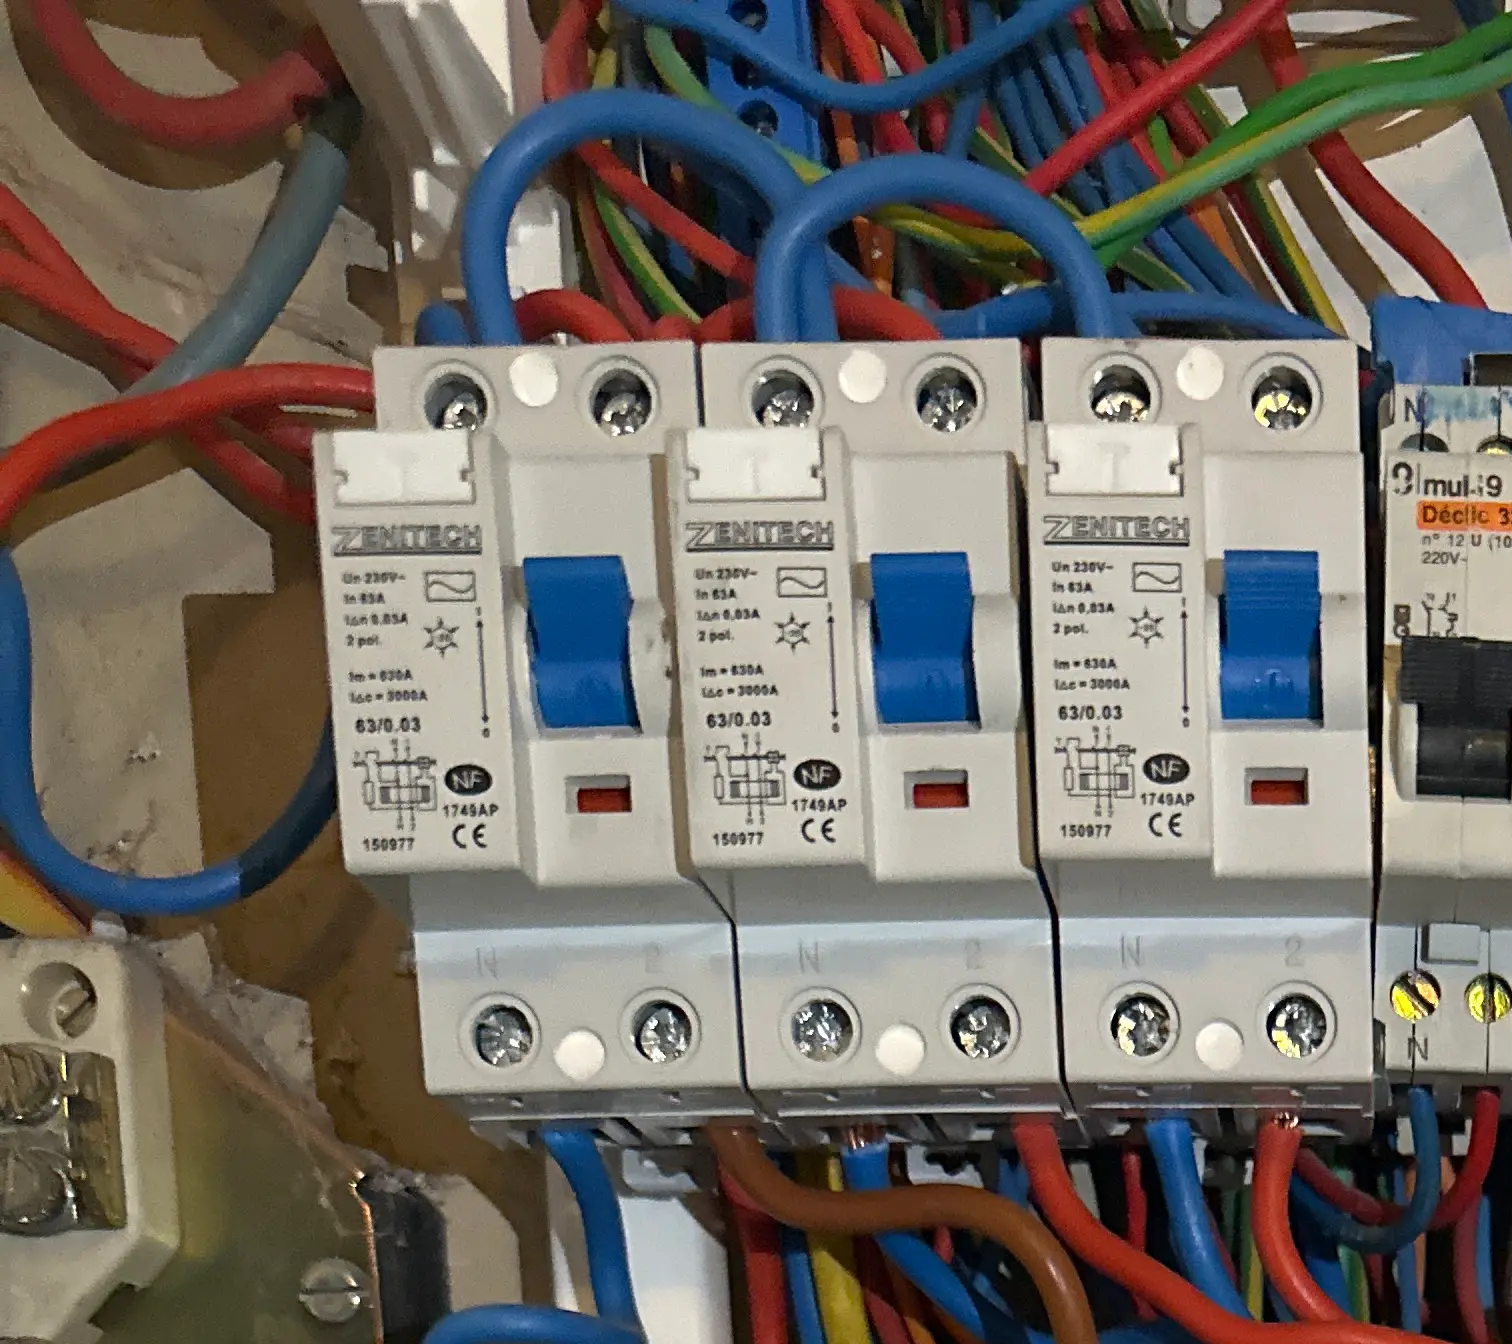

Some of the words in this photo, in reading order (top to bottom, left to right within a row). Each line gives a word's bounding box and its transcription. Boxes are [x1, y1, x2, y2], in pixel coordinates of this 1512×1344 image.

[1422, 504, 1489, 525] Déclic
[684, 522, 835, 552] ZENITECH
[1042, 515, 1191, 546] ZENITECH
[331, 525, 483, 556] ZENITECH
[1447, 534, 1465, 547] 12
[705, 711, 772, 727] 63/0.03
[1058, 704, 1123, 721] 63/0.03
[355, 717, 422, 734] 63/0.03
[790, 798, 848, 812] 1749AP
[1140, 793, 1195, 807] 1749AP
[442, 803, 500, 818] 1749AP
[800, 818, 836, 843] CE
[1060, 824, 1112, 838] 150977
[1148, 812, 1183, 838] CE
[362, 837, 415, 851] 150977
[452, 824, 488, 849] CE
[712, 831, 764, 845] 150977
